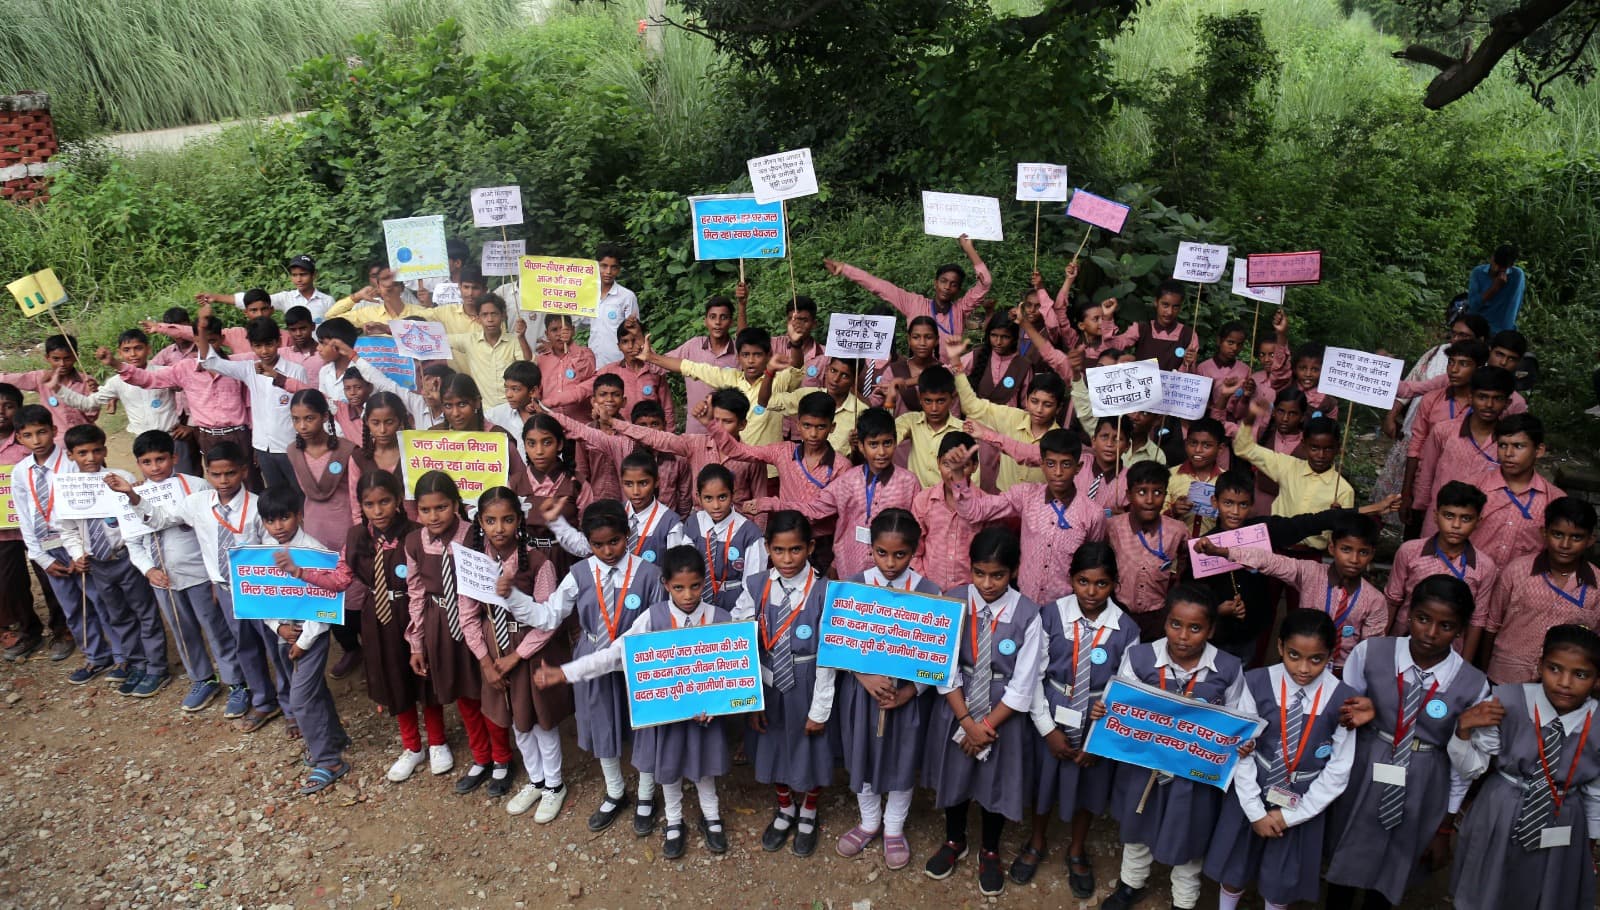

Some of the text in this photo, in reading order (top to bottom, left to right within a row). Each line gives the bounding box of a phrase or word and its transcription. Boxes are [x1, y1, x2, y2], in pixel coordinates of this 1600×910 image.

[543, 300, 552, 308] हर
[564, 302, 577, 310] जल
[554, 289, 563, 297] घर
[564, 290, 576, 298] नल
[413, 438, 497, 452] जल जीवन मिशन
[411, 456, 502, 472] से मिल रहा गांव को
[455, 478, 483, 491] जीवन
[238, 566, 251, 576] हर
[253, 566, 266, 576] घर
[241, 582, 337, 599] मिल रहा स्वच्छ पेयजल
[833, 598, 853, 610] आओ
[876, 605, 892, 617] जल
[894, 607, 919, 622] संरक्षण
[921, 612, 932, 625] की
[934, 615, 950, 628] ओर
[832, 616, 946, 645] एक कदम जल जीवन मिशन से
[634, 649, 654, 663] आओ
[677, 646, 692, 657] जल
[694, 642, 719, 655] संरक्षण
[720, 638, 732, 651] की
[733, 638, 748, 650] ओर
[824, 634, 948, 664] बदल रहा यूपी के ग्रामीणों का कल
[637, 657, 749, 682] एक कदम जल जीवन मिशन से
[635, 677, 755, 701] बदल रहा यूपी के ग्रामीणों का कल
[1111, 702, 1240, 747] हर घर नल, हर घर जल
[1105, 717, 1228, 765] मिल रहा स्वच्छ पेयजल
